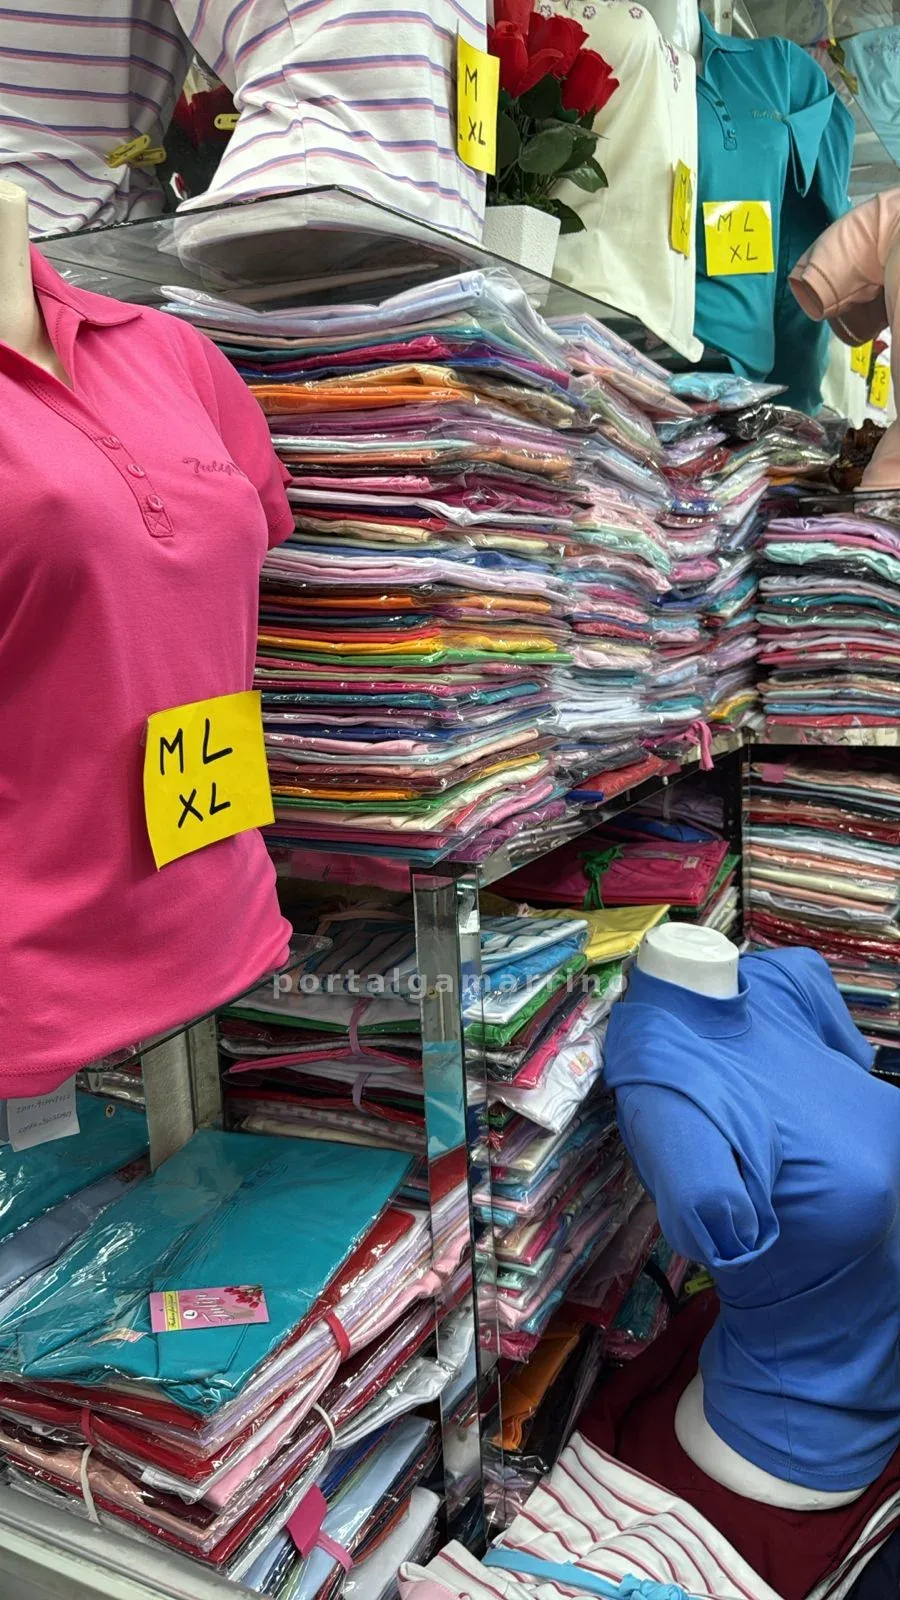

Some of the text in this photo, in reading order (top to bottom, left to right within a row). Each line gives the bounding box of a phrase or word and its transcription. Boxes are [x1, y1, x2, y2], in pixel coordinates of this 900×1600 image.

[464, 63, 478, 103] M
[468, 115, 487, 146] XL
[717, 210, 755, 232] M L
[730, 241, 759, 264] XL
[159, 717, 234, 776] M L
[177, 781, 232, 829] XL
